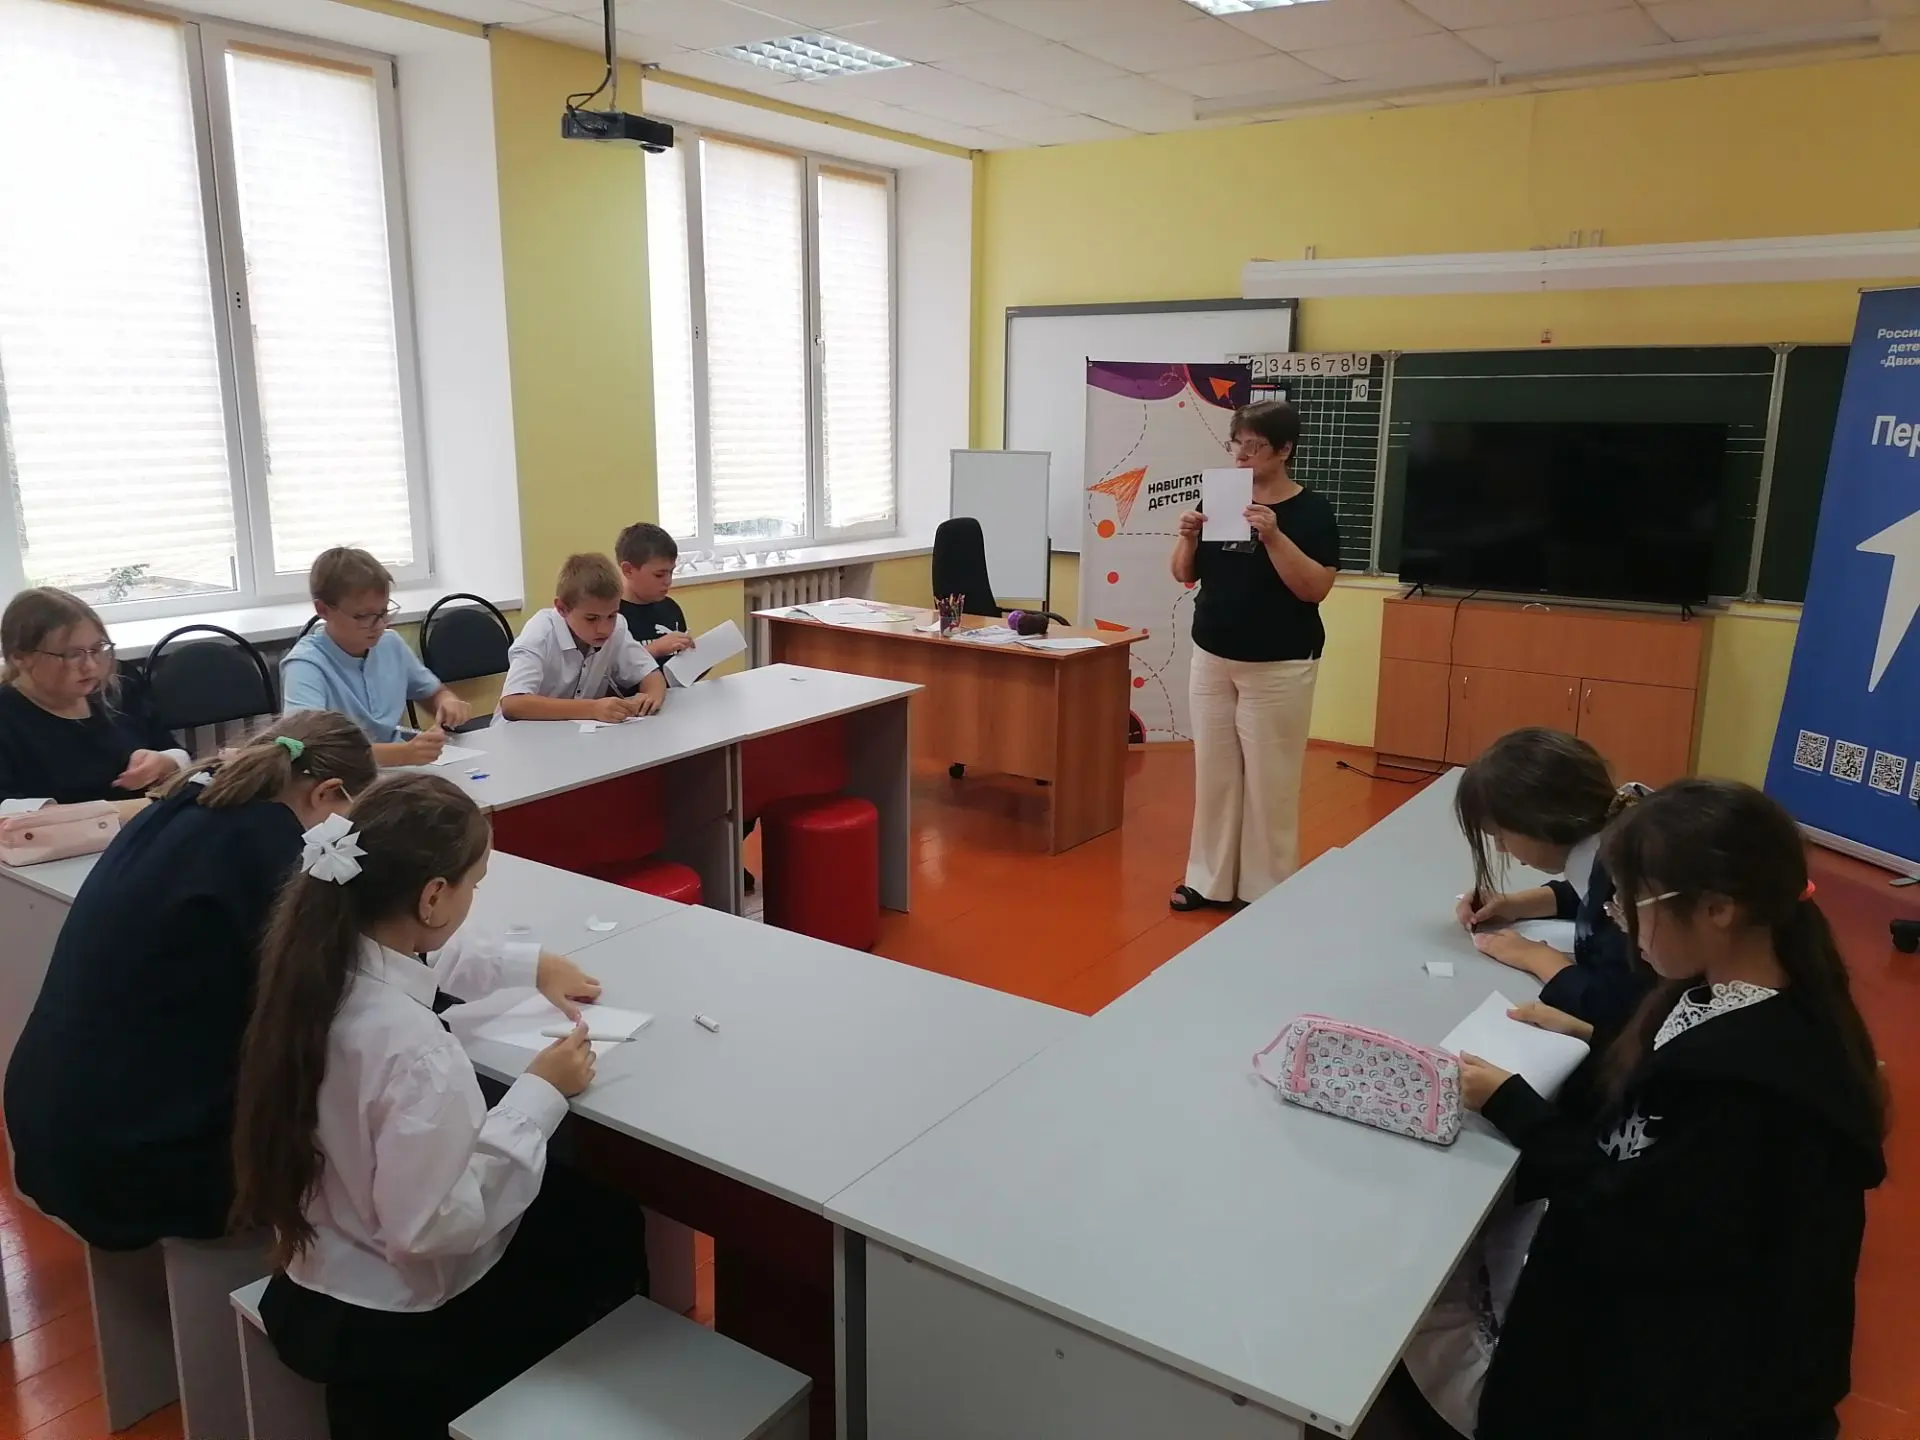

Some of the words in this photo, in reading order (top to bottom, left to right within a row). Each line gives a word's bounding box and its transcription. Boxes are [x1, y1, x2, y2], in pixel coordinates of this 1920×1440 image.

[1877, 328, 1920, 339] Росси
[1354, 384, 1367, 398] 10
[1148, 488, 1200, 511] ДЕТСТВА
